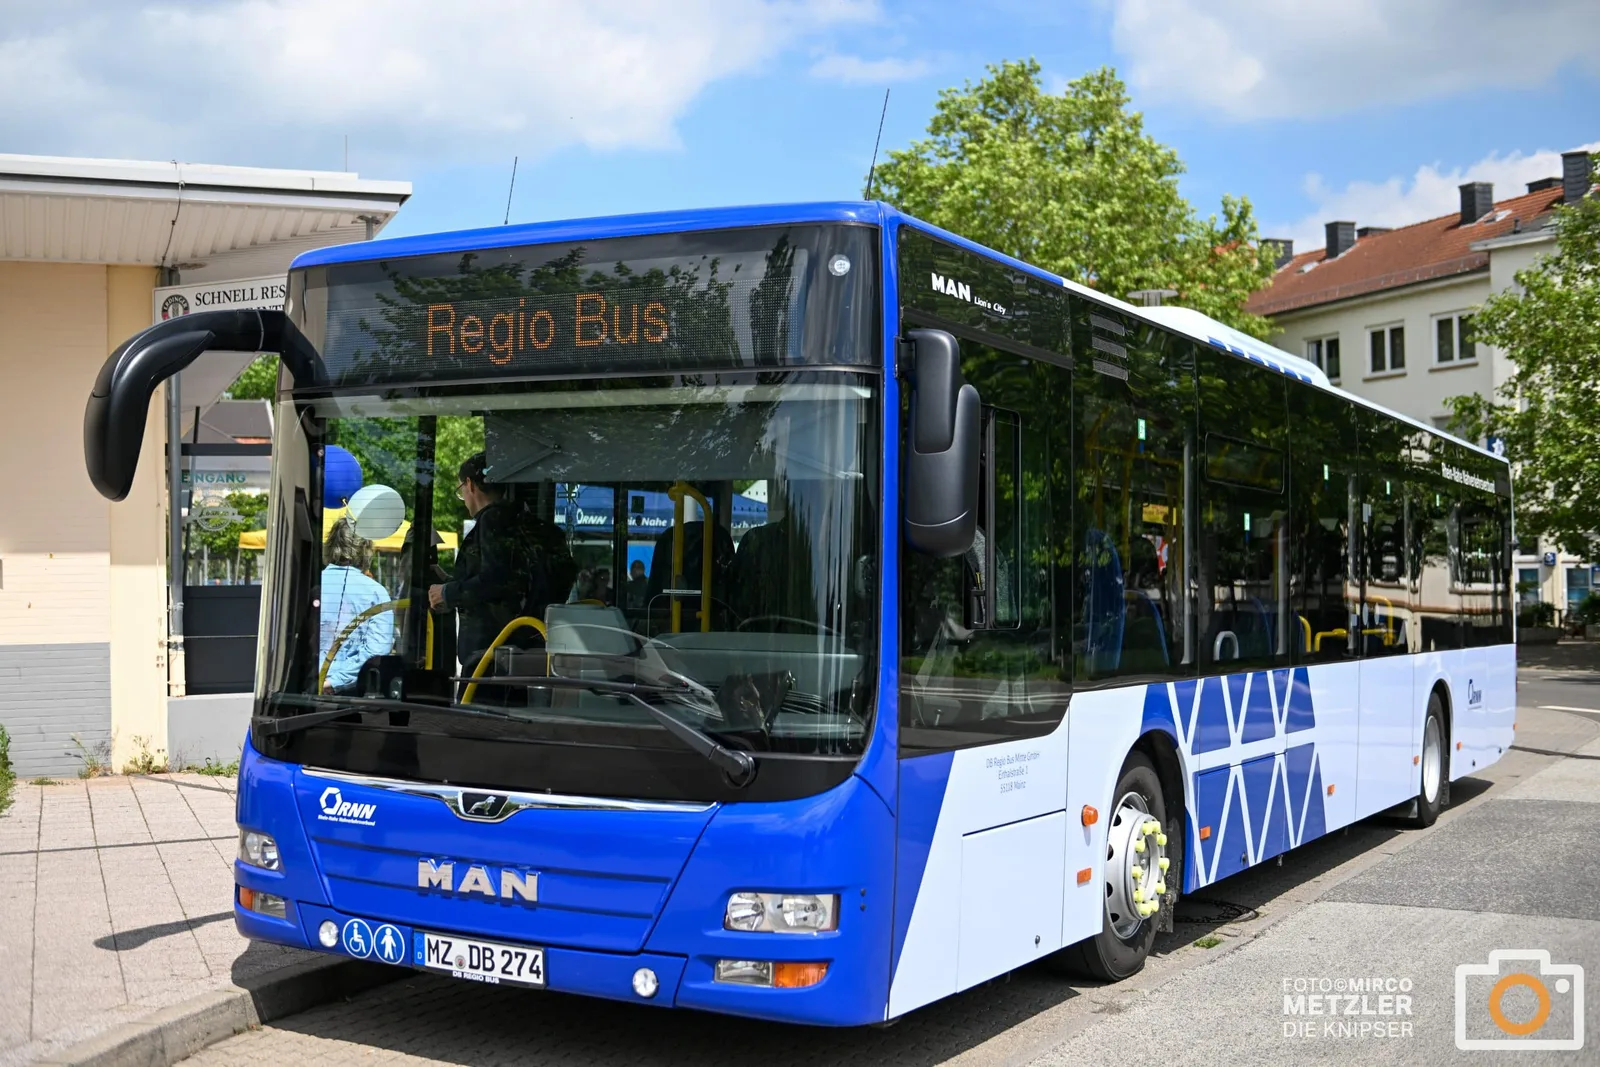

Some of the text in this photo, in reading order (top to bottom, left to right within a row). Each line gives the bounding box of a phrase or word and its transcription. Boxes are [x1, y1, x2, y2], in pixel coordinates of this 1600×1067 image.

[195, 284, 286, 307] SCHNELL RES
[931, 272, 1007, 315] MAN Lion's City
[427, 293, 669, 365] Regio Bus
[181, 471, 246, 483] EINGANG
[418, 857, 541, 902] MAN
[417, 951, 423, 960] D
[427, 937, 542, 980] MZ DB 274
[452, 970, 500, 984] DB REGIO BUS
